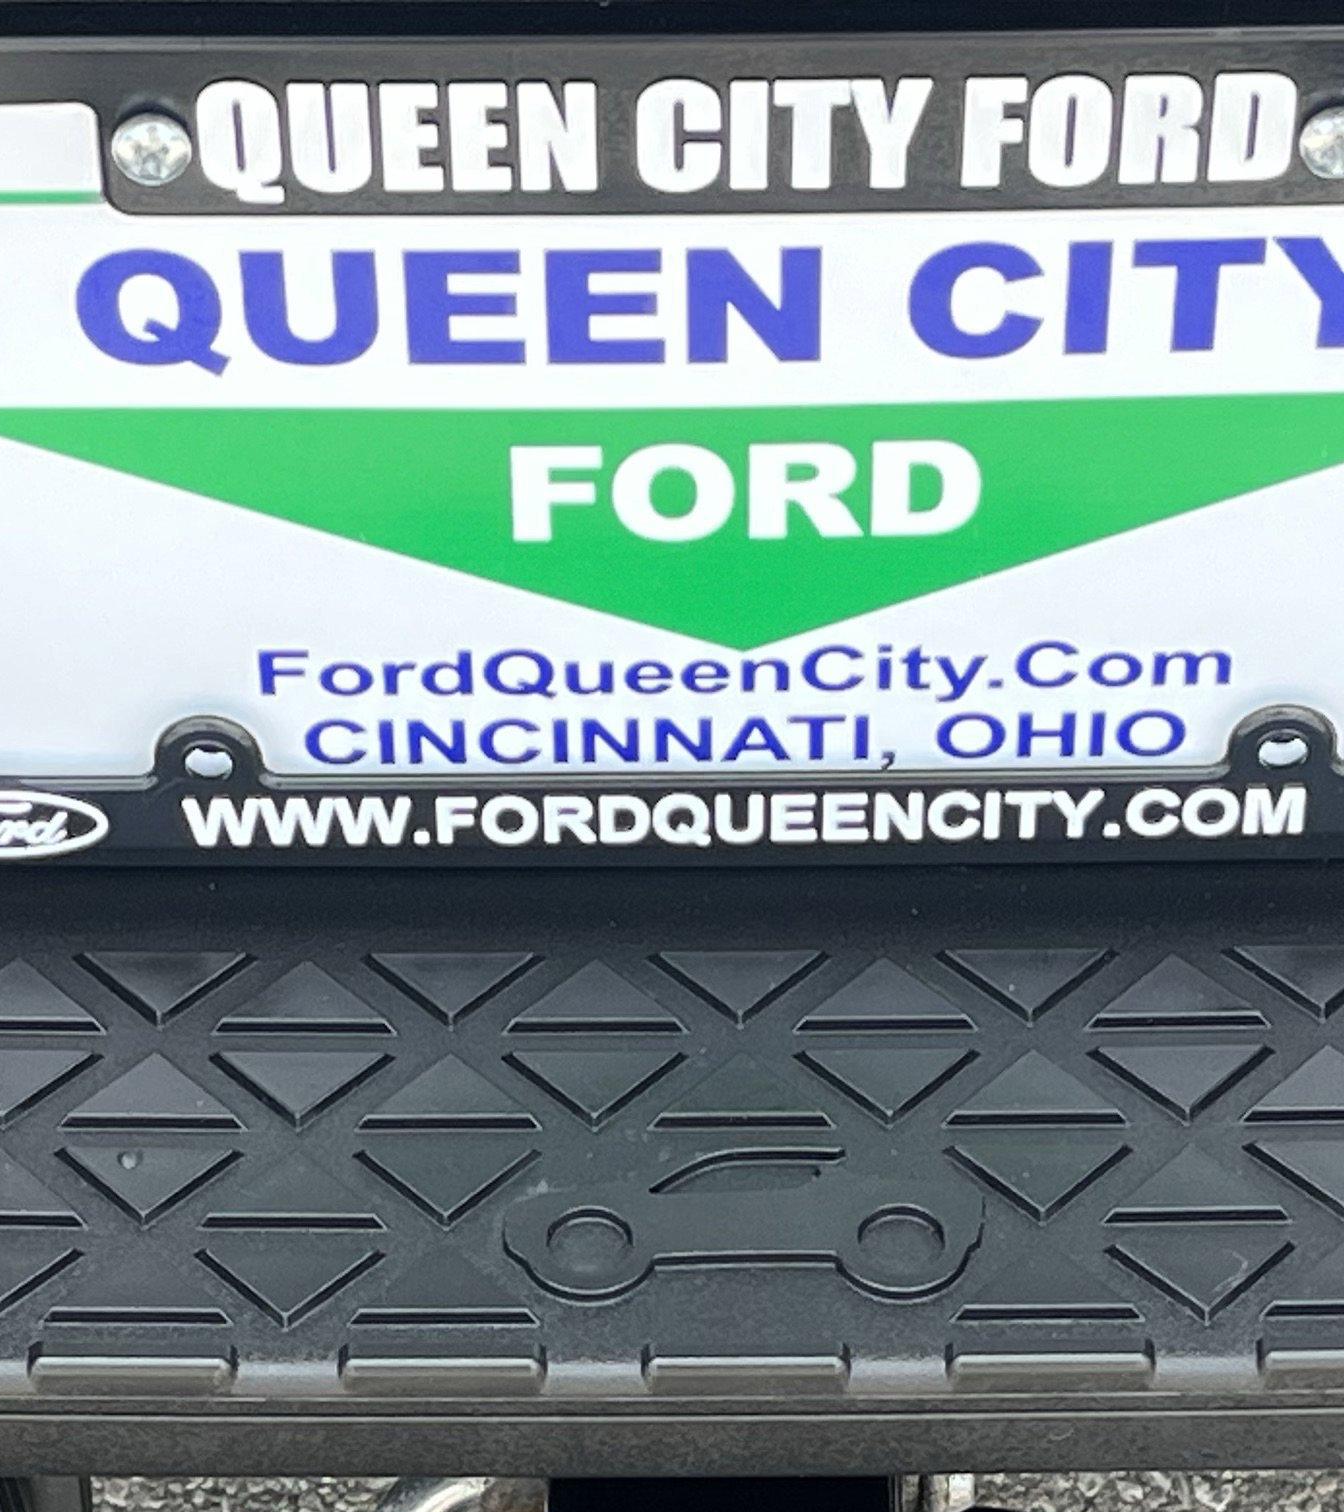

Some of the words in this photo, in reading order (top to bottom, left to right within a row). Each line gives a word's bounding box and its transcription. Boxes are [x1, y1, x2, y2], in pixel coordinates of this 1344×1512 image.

[195, 79, 598, 205] QUEEN
[636, 76, 934, 193] CITY
[960, 72, 1299, 188] FORD
[75, 245, 822, 376] QUEEN
[509, 439, 983, 542] FORD
[257, 640, 1233, 702] FordQueenCity.Com
[303, 710, 897, 771] CINCINNATI,
[934, 708, 1187, 760] OHIO
[181, 786, 1307, 848] WWW.FORDQUEENCITY.COM
